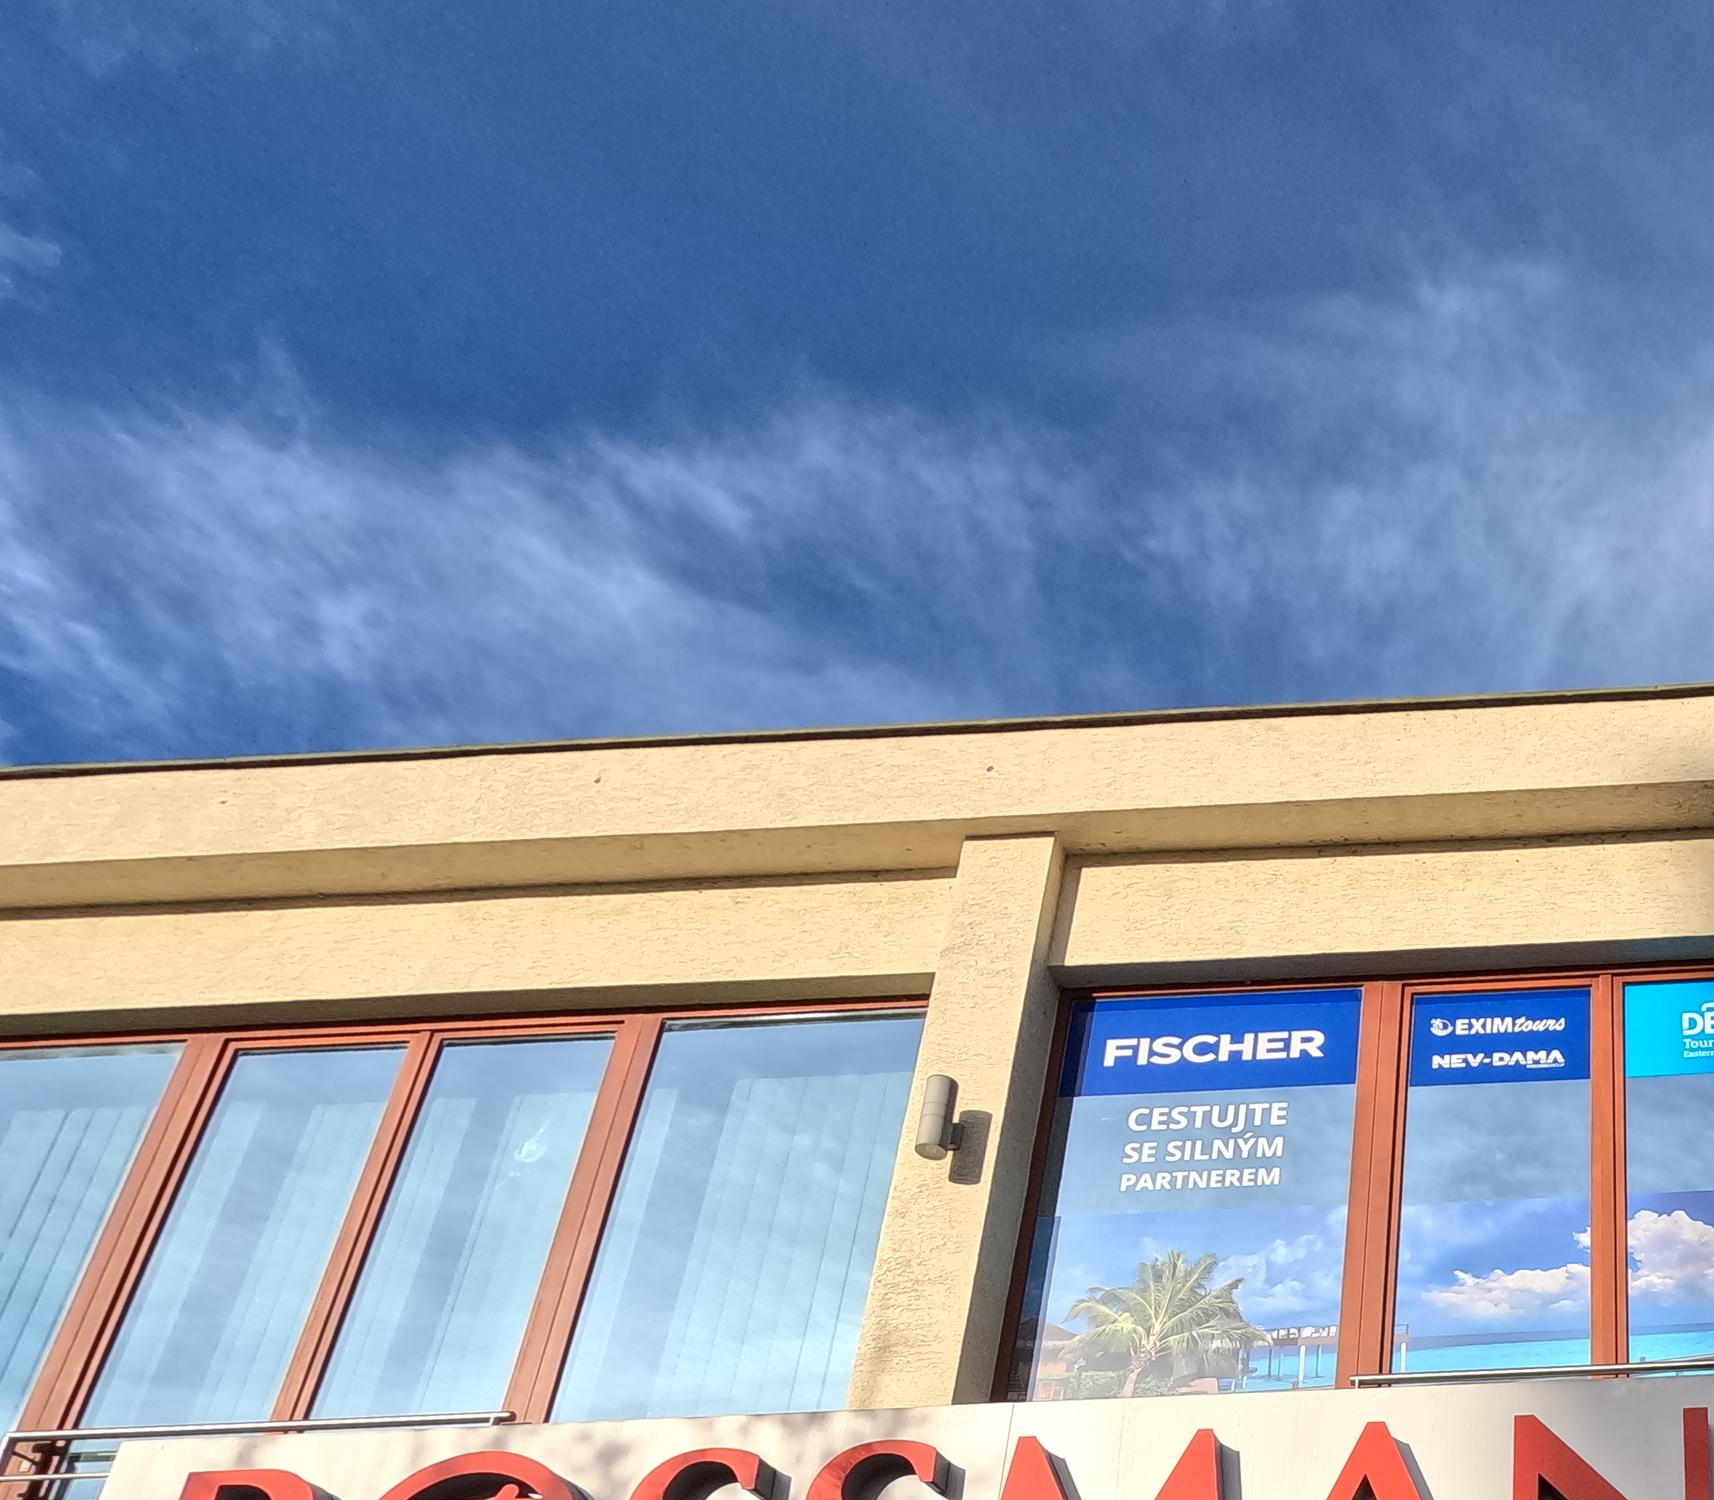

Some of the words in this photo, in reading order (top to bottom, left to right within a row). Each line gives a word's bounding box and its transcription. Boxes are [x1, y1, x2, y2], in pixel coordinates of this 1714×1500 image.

[1103, 1030, 1325, 1068] FISCHER
[1431, 1049, 1566, 1070] NEV-DAMA
[1127, 1102, 1290, 1134] CESTUJTE
[1123, 1140, 1157, 1166] SE
[1165, 1132, 1285, 1162] SILNÝM
[1119, 1166, 1281, 1193] PARTNEREM
